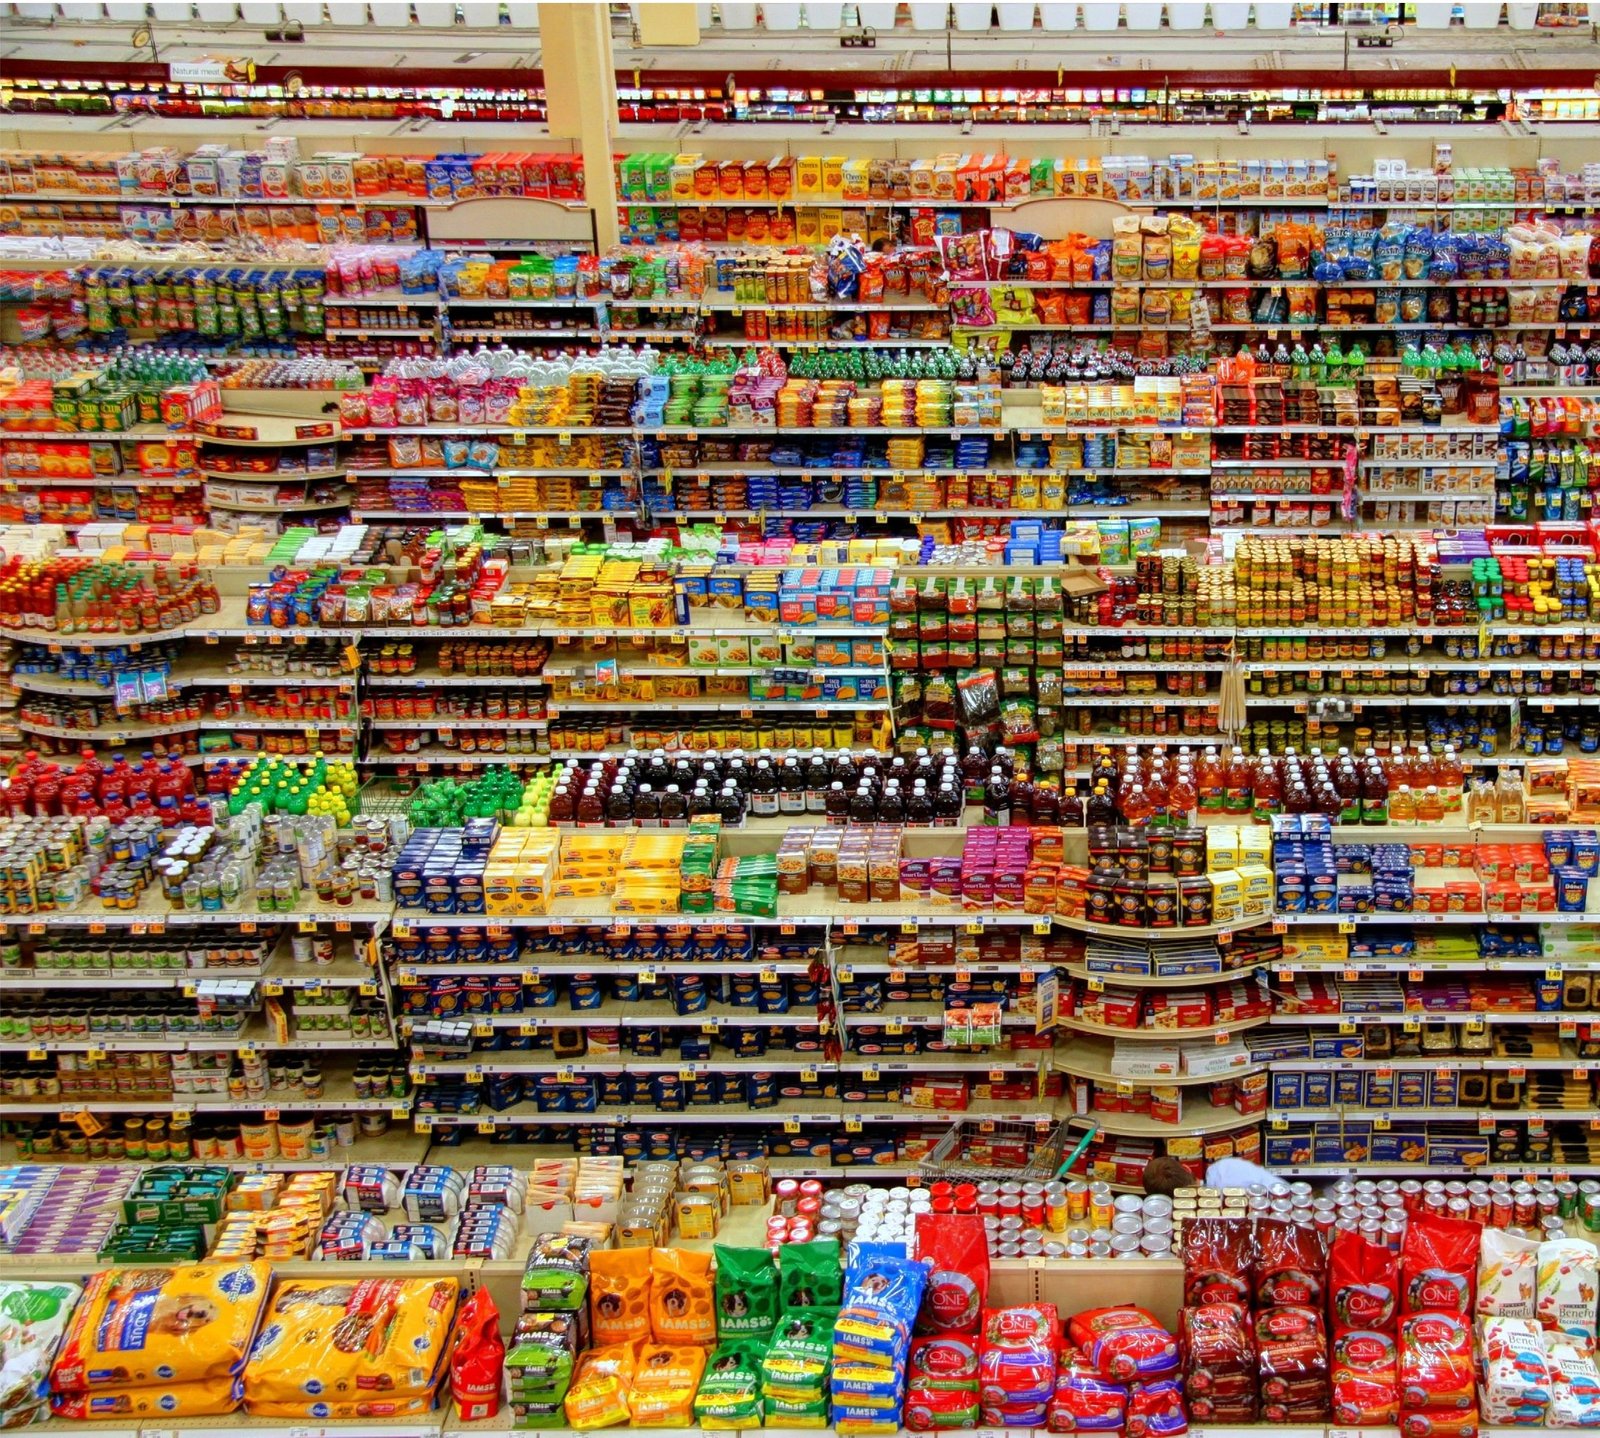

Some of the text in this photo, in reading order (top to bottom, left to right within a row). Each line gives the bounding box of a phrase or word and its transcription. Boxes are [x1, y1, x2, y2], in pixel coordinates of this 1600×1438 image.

[173, 67, 220, 76] Natural meat
[1105, 172, 1125, 180] Total
[1129, 170, 1148, 178] Total
[732, 395, 747, 404] 100
[755, 399, 770, 408] 100
[537, 1256, 574, 1267] IAMS
[227, 1262, 252, 1304] Pedigree
[848, 1289, 889, 1309] IAMS
[933, 1292, 965, 1306] ONE
[1202, 1292, 1234, 1304] ONE
[1273, 1287, 1305, 1300] ONE
[1423, 1287, 1456, 1301] ONE
[597, 1318, 636, 1330] IAMS
[660, 1318, 699, 1330] IAMS
[720, 1317, 760, 1329] IAMS
[1000, 1320, 1034, 1332] ONE
[1270, 1319, 1300, 1328] ONE
[134, 1311, 151, 1350] ADULT
[1416, 1324, 1449, 1336] ONE
[521, 1331, 556, 1341] IAMS
[843, 1333, 868, 1345] IAMS
[776, 1339, 815, 1351] IAMS
[1349, 1344, 1381, 1354] ONE
[640, 1368, 680, 1379] IAMS
[705, 1371, 747, 1382] IAMS
[467, 1383, 491, 1392] IAMS
[843, 1380, 869, 1391] IAMS
[845, 1408, 871, 1417] IAMS
